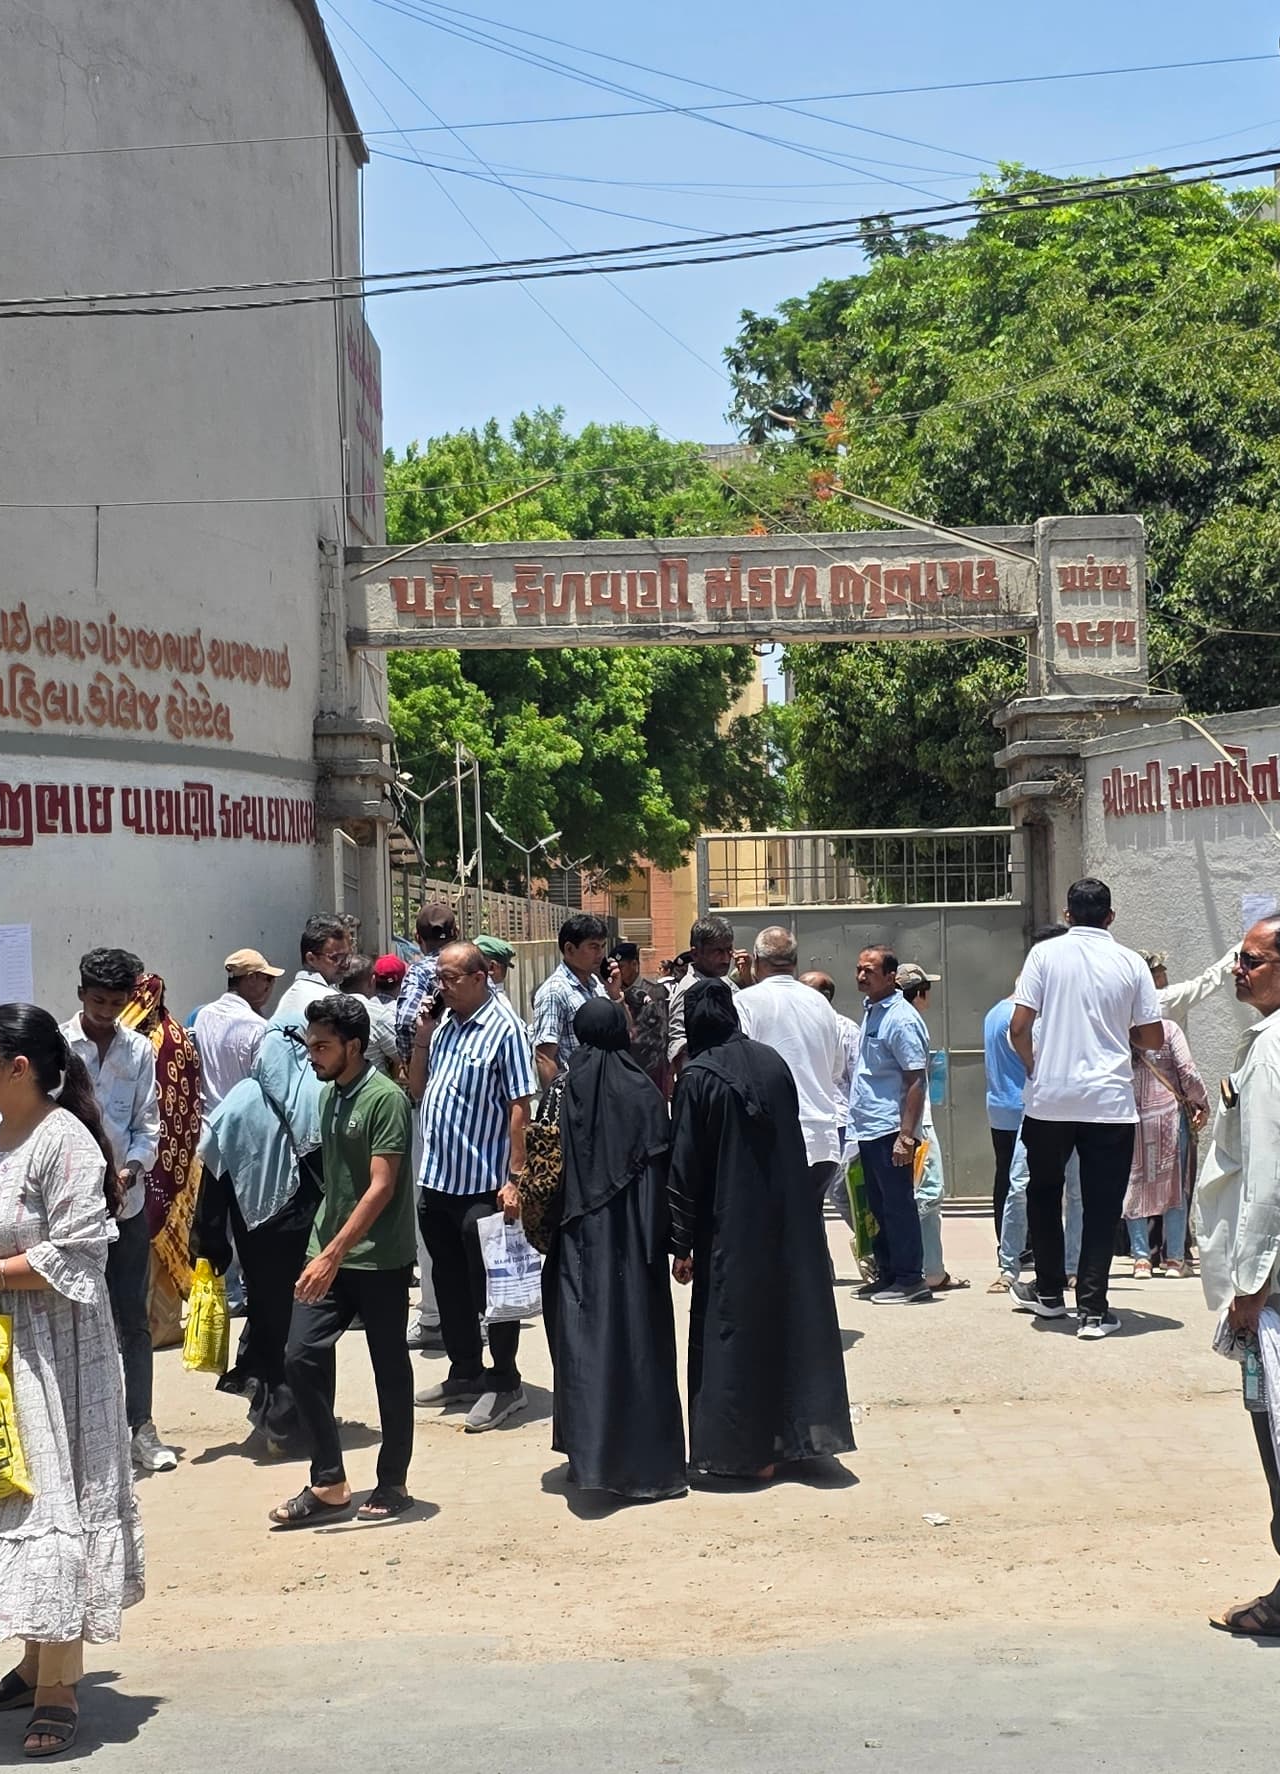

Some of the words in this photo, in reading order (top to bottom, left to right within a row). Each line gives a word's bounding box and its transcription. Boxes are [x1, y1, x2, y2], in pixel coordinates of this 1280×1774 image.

[389, 564, 501, 618] પટેલ
[511, 558, 693, 616] કેળવણી
[704, 555, 822, 609] મંડળ
[85, 670, 160, 731] કોલેજ
[165, 678, 234, 742] હોસ્ટેલ
[1102, 758, 1167, 817] શ્રીમતી
